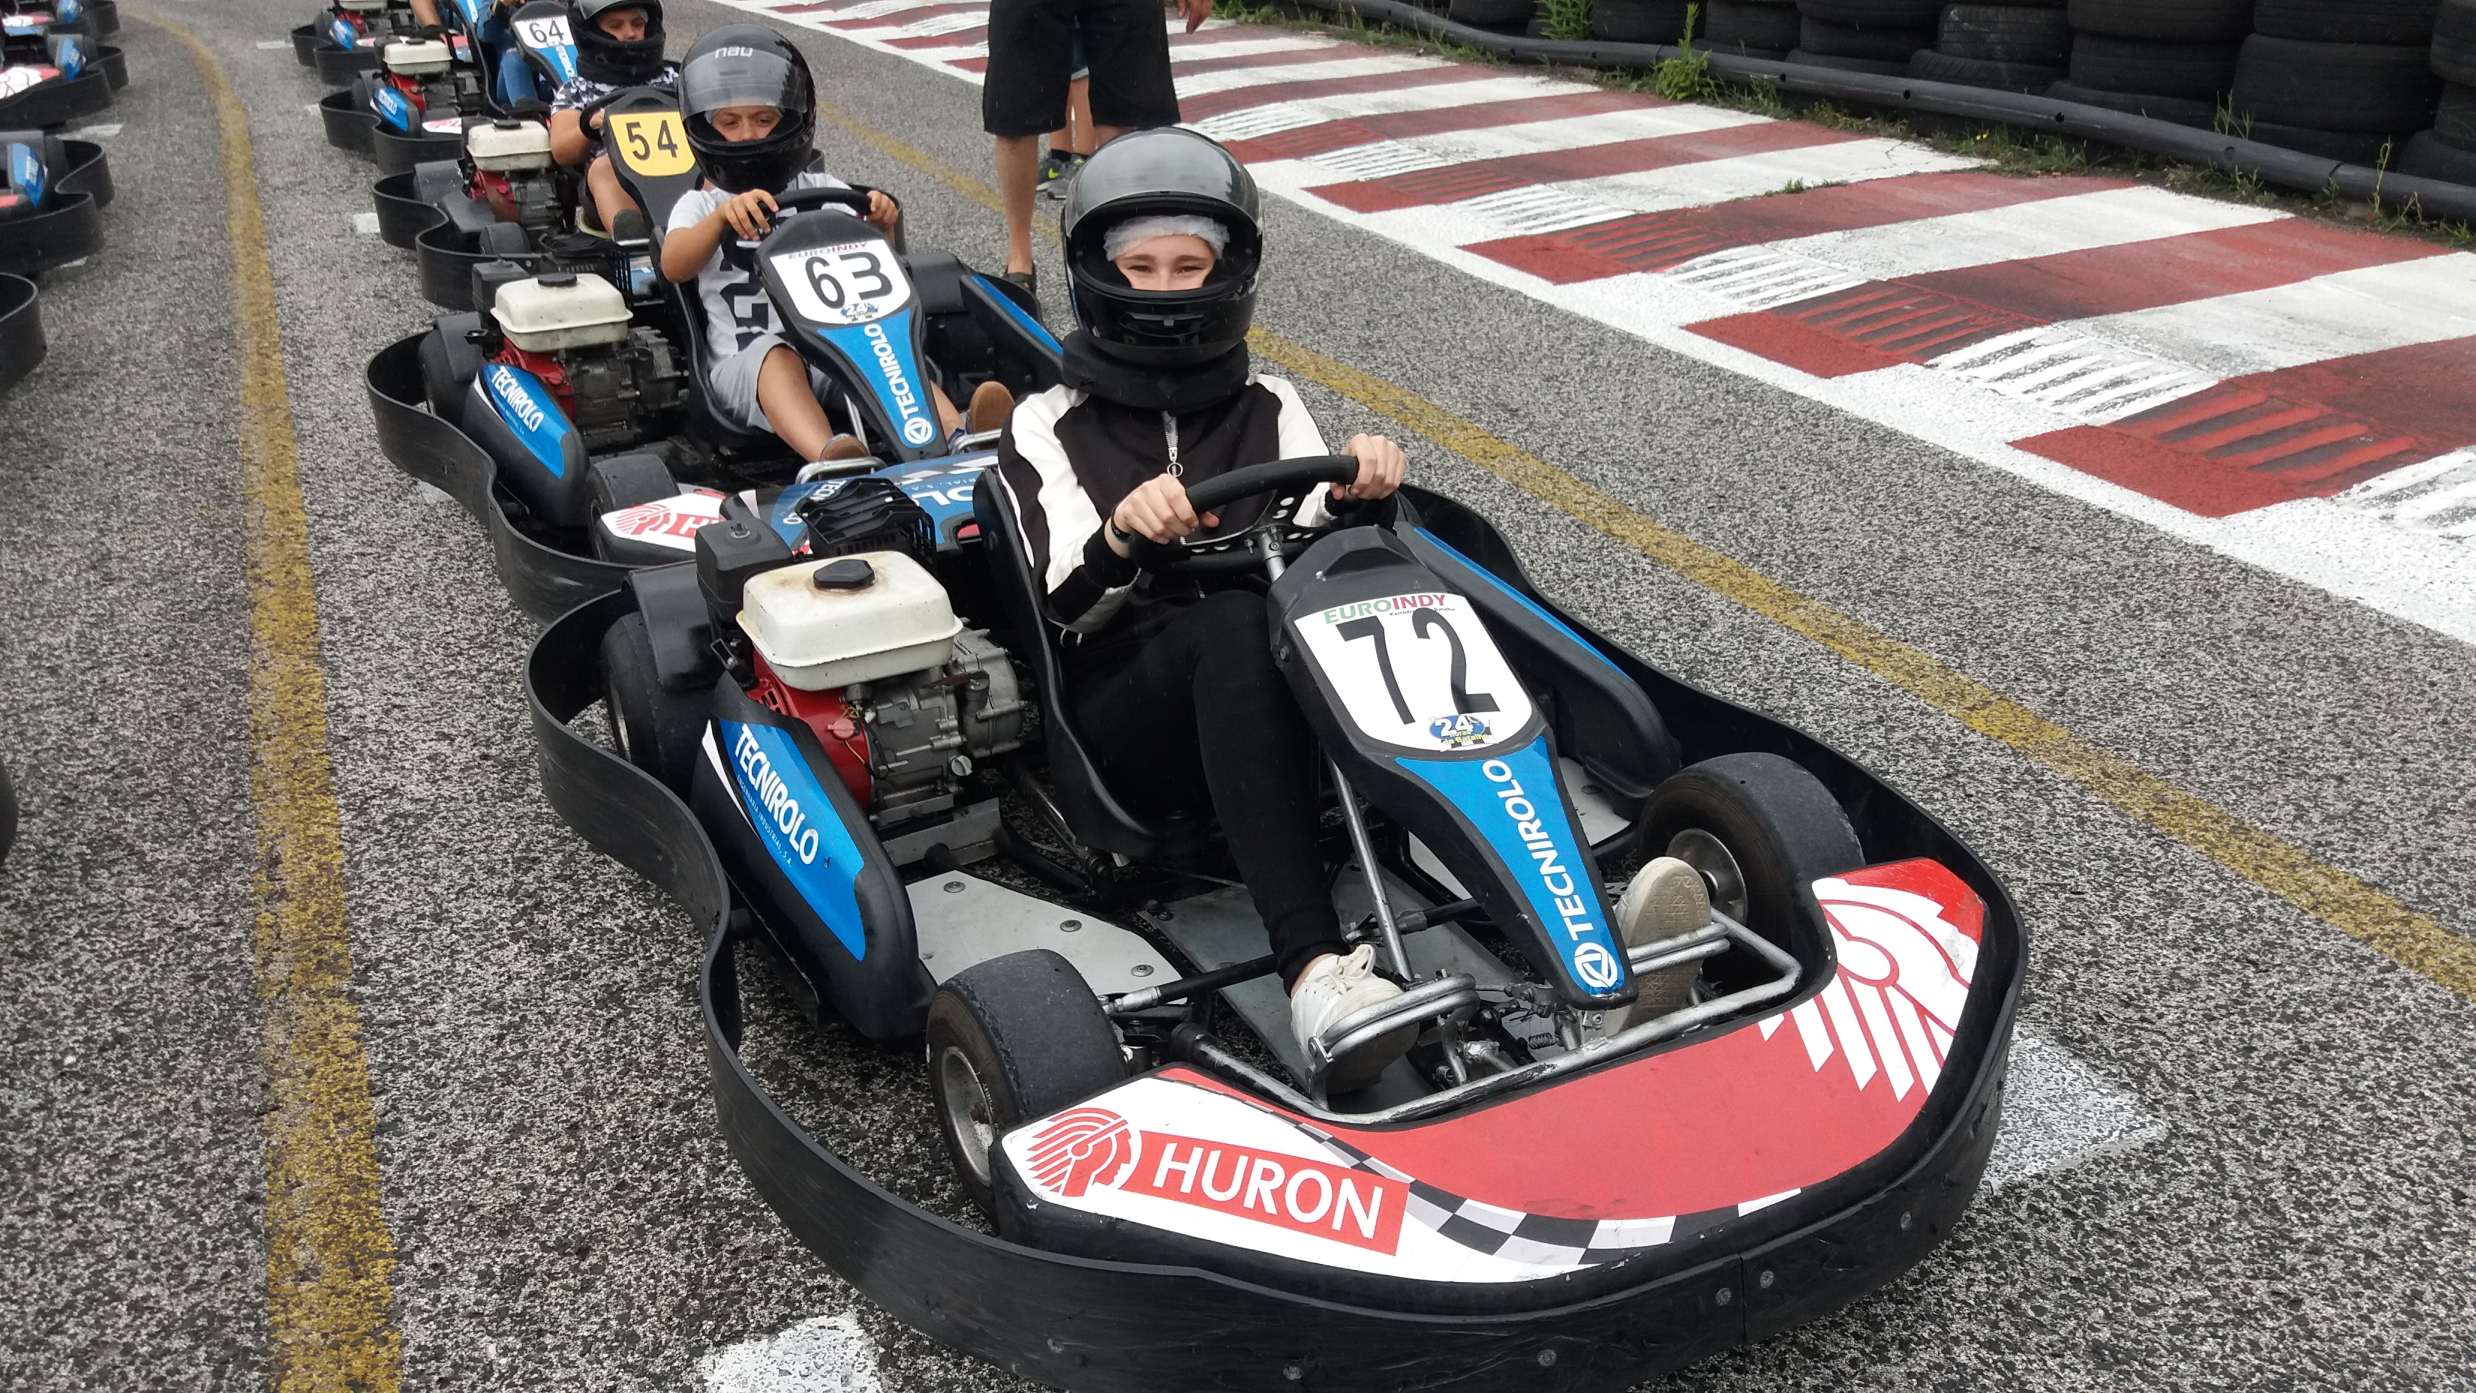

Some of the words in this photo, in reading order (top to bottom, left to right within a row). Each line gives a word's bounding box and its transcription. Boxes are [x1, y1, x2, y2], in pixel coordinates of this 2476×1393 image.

[529, 20, 564, 43] 64
[714, 46, 754, 59] nau
[626, 119, 678, 161] 54
[805, 251, 893, 309] 63
[491, 365, 544, 432] TECNIROLO
[864, 323, 919, 420] TECNIROLO
[1324, 594, 1446, 624] EUROINDY
[1336, 607, 1500, 725] 72
[1434, 715, 1473, 737] 24
[735, 723, 819, 865] TECNIROLO
[1482, 760, 1595, 941] TECNIROLO
[1152, 1142, 1383, 1239] HURON
